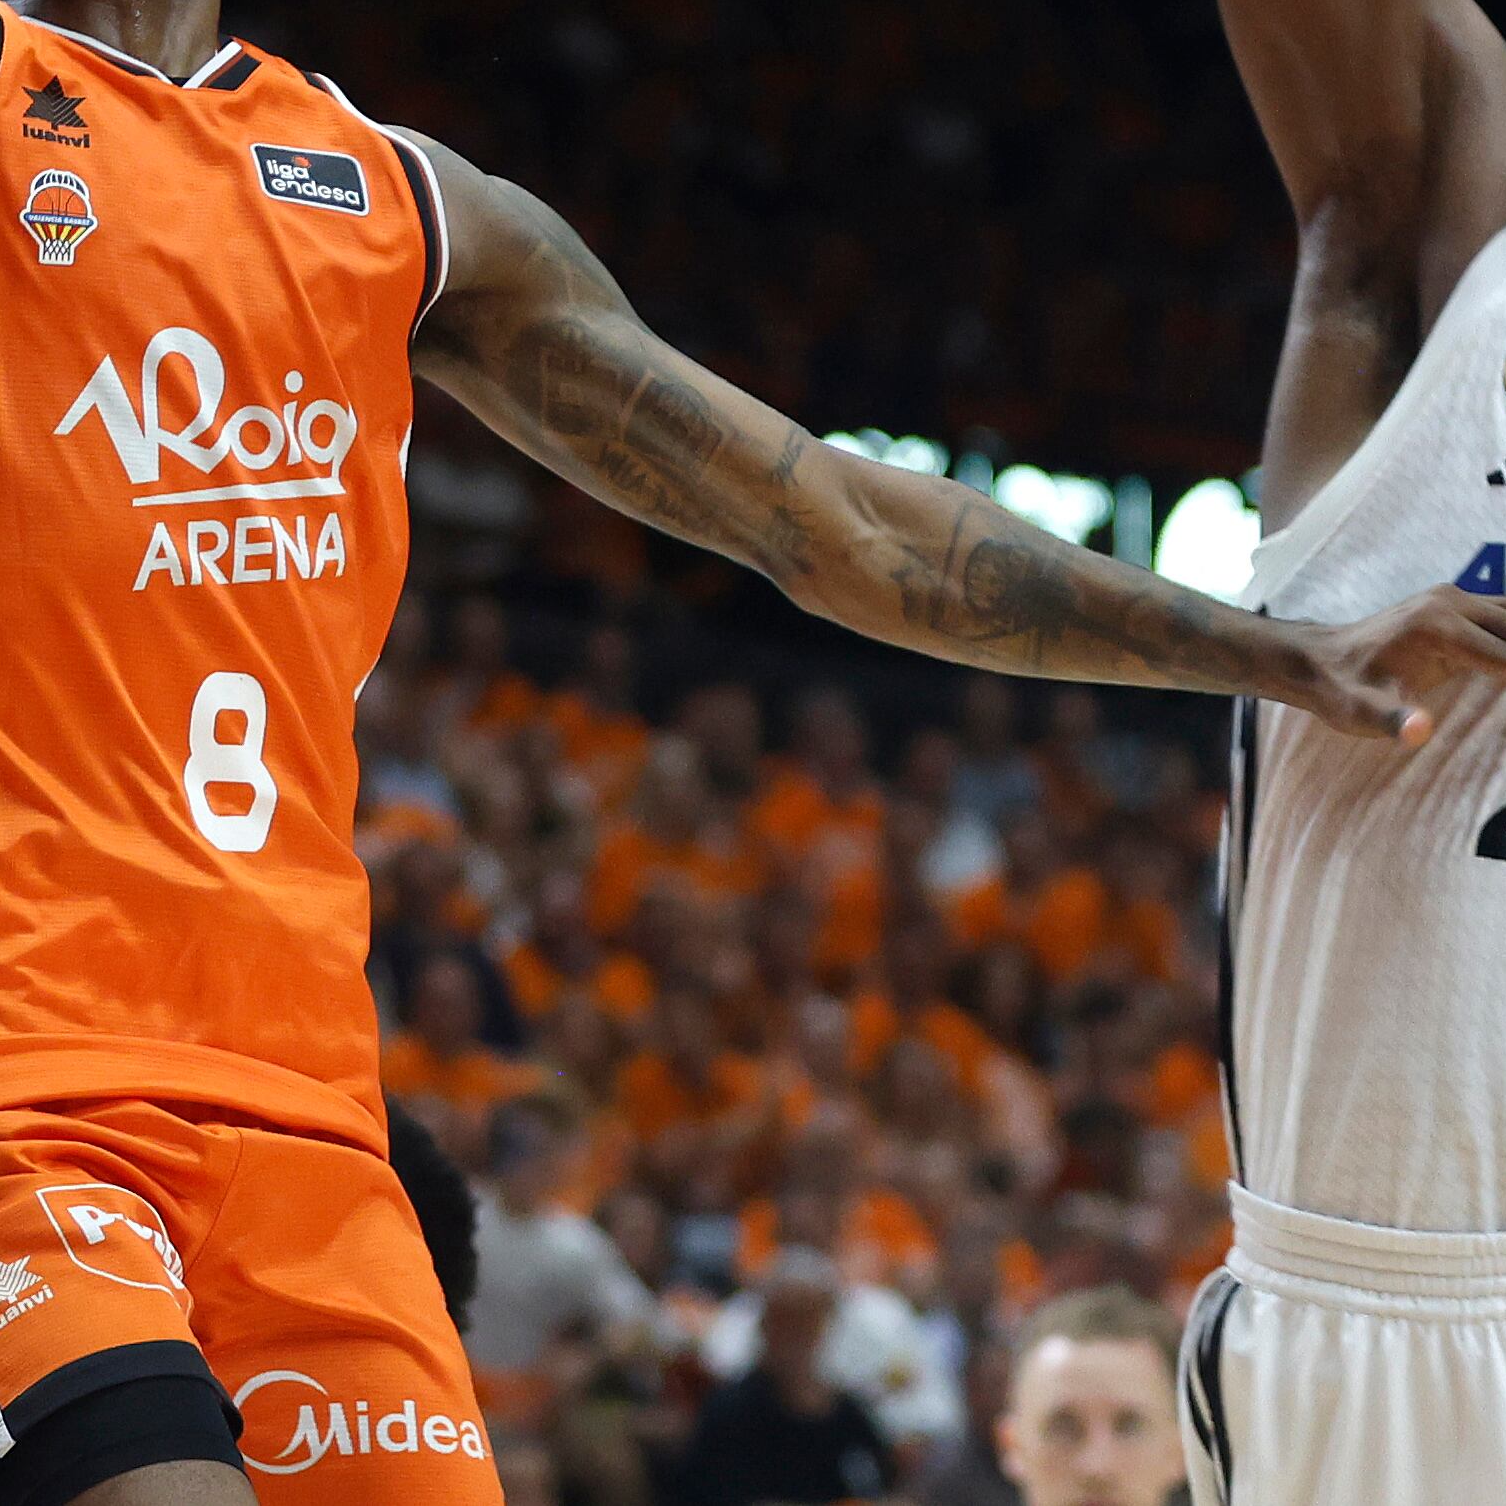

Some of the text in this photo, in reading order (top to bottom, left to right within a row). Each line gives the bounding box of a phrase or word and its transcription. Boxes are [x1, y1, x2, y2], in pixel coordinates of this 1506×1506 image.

[22, 123, 91, 149] luanvi
[265, 159, 310, 180] liga
[271, 178, 361, 206] endesa
[53, 326, 358, 494] Roig
[133, 512, 346, 592] ARENA
[183, 671, 278, 853] 8
[273, 1398, 486, 1466] Midea
